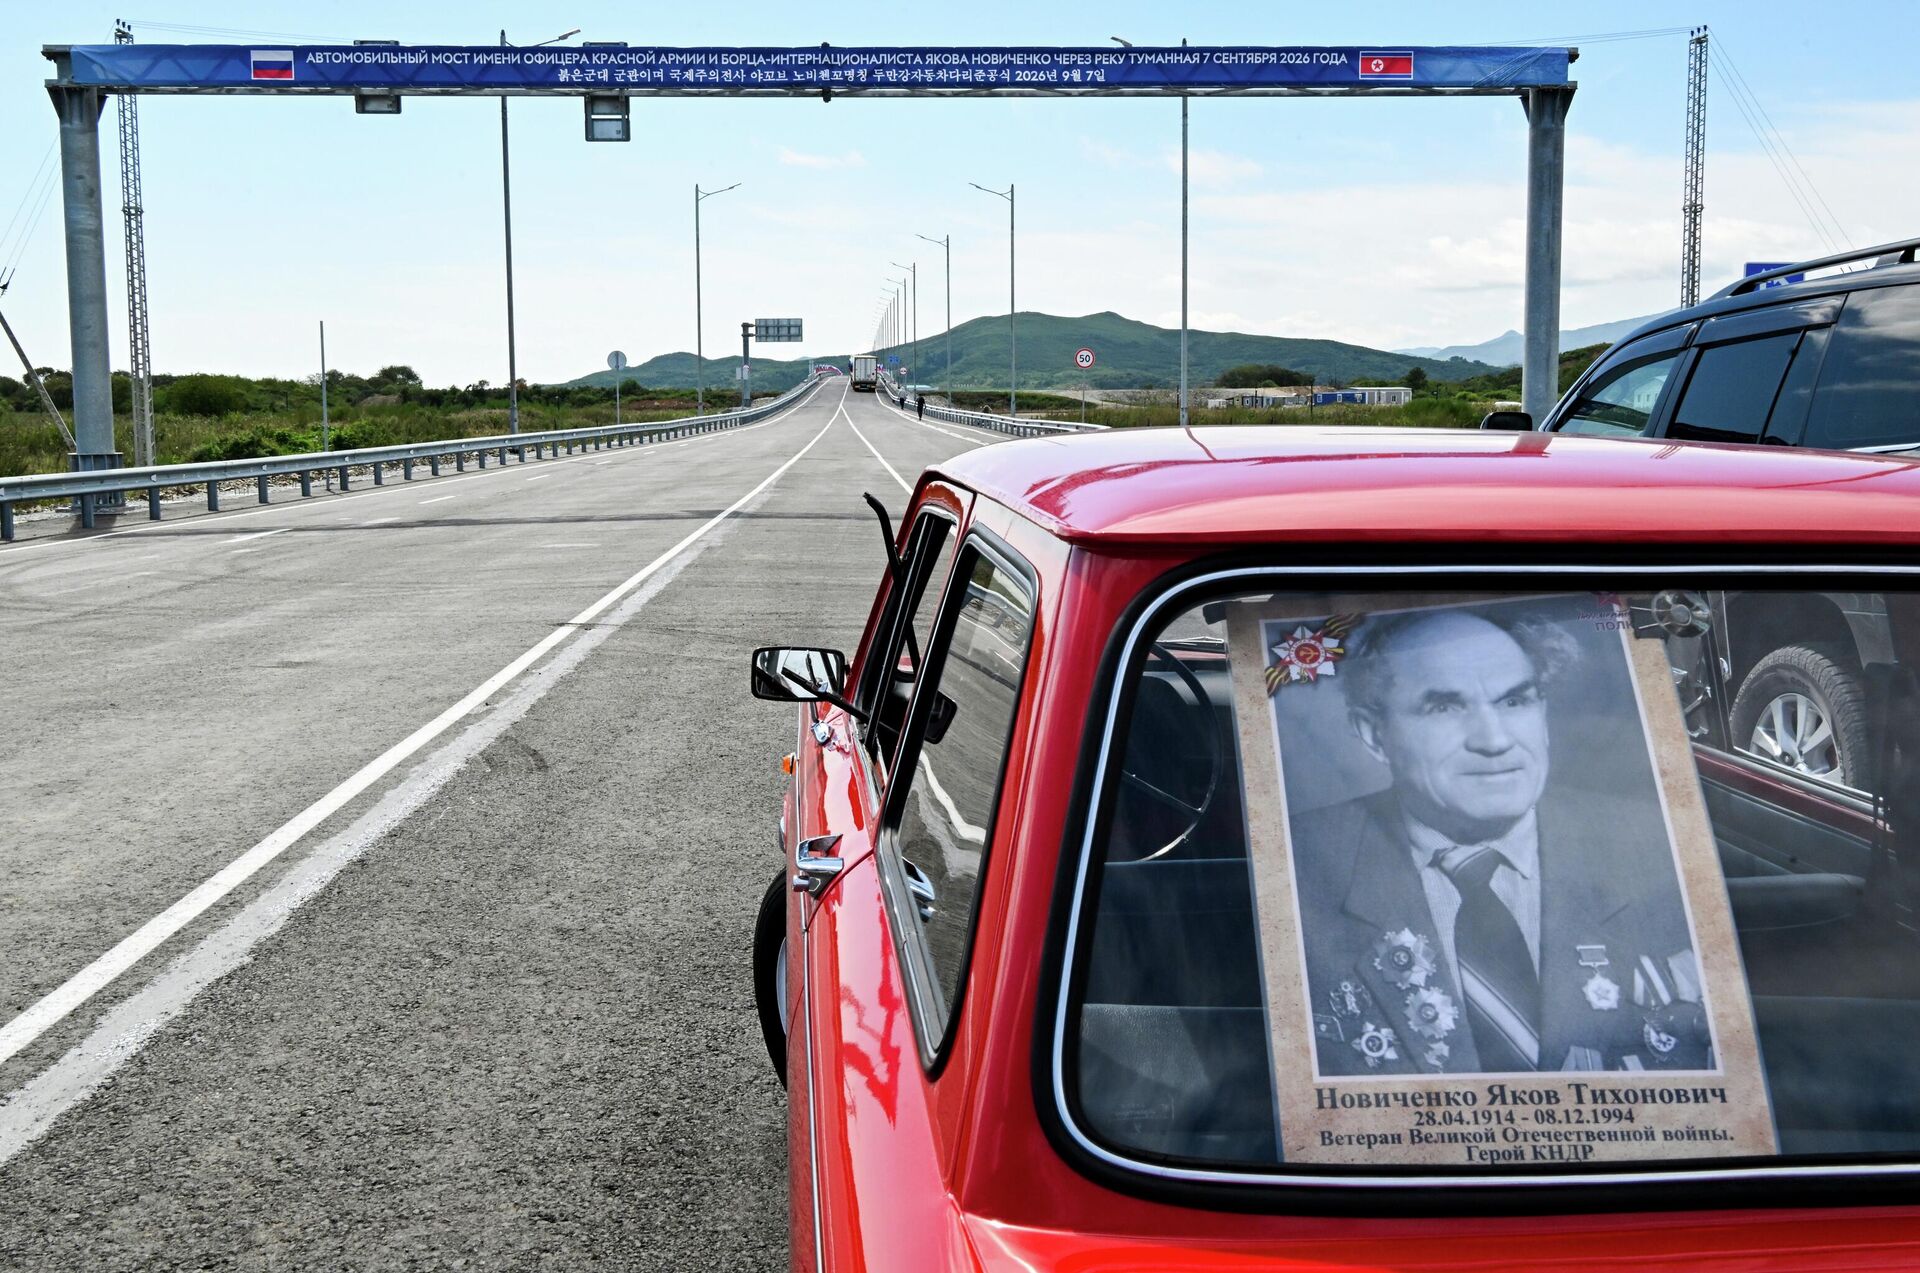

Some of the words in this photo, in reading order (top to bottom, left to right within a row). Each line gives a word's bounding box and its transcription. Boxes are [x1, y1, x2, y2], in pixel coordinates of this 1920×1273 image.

[306, 50, 428, 64] АВТОМОБИЛЬНЫЙ
[432, 52, 470, 64] МОСТ
[474, 52, 521, 64] ИМЕНИ
[524, 52, 589, 66] ОФИЦЕРА
[592, 51, 655, 65] КРАСНОЙ
[659, 53, 706, 65] АРМИИ
[709, 53, 718, 65] И
[721, 53, 922, 67] БОРЦА-ИНТЕРНАЦИОНАЛИСТА
[925, 53, 969, 65] ЯКОВА
[972, 53, 1051, 65] НОВИЧЕНКО
[1054, 53, 1092, 65] ЧЕРЕЗ
[1095, 53, 1125, 65] РЕКУ
[1128, 53, 1200, 65] ТУМАННАЯ
[1203, 53, 1210, 64] 7
[1213, 53, 1276, 64] СЕНТЯБРЯ
[1279, 53, 1310, 64] 2026
[1312, 53, 1348, 66] ГОДА
[614, 68, 664, 82] 군관이며
[670, 68, 746, 82] 국제주의전사
[750, 68, 788, 82] 야꼬브
[873, 68, 1010, 82] 두만강자동차다리준공식
[1015, 69, 1058, 82] 2026년
[1062, 68, 1082, 82] 9월
[1086, 69, 1106, 82] 7일
[1079, 354, 1091, 363] 50
[1314, 1087, 1477, 1109] Новиченко
[1486, 1083, 1560, 1105] Яков
[1568, 1082, 1728, 1104] Тихонович
[1413, 1108, 1515, 1127] 28.04.1914
[1534, 1108, 1635, 1125] 08.12.1994
[1319, 1130, 1402, 1149] Ветеран
[1409, 1127, 1496, 1145] Великой
[1502, 1125, 1655, 1144] Отечественной
[1662, 1125, 1735, 1142] войны.
[1465, 1144, 1526, 1164] Герой
[1532, 1145, 1594, 1163] КНДР
